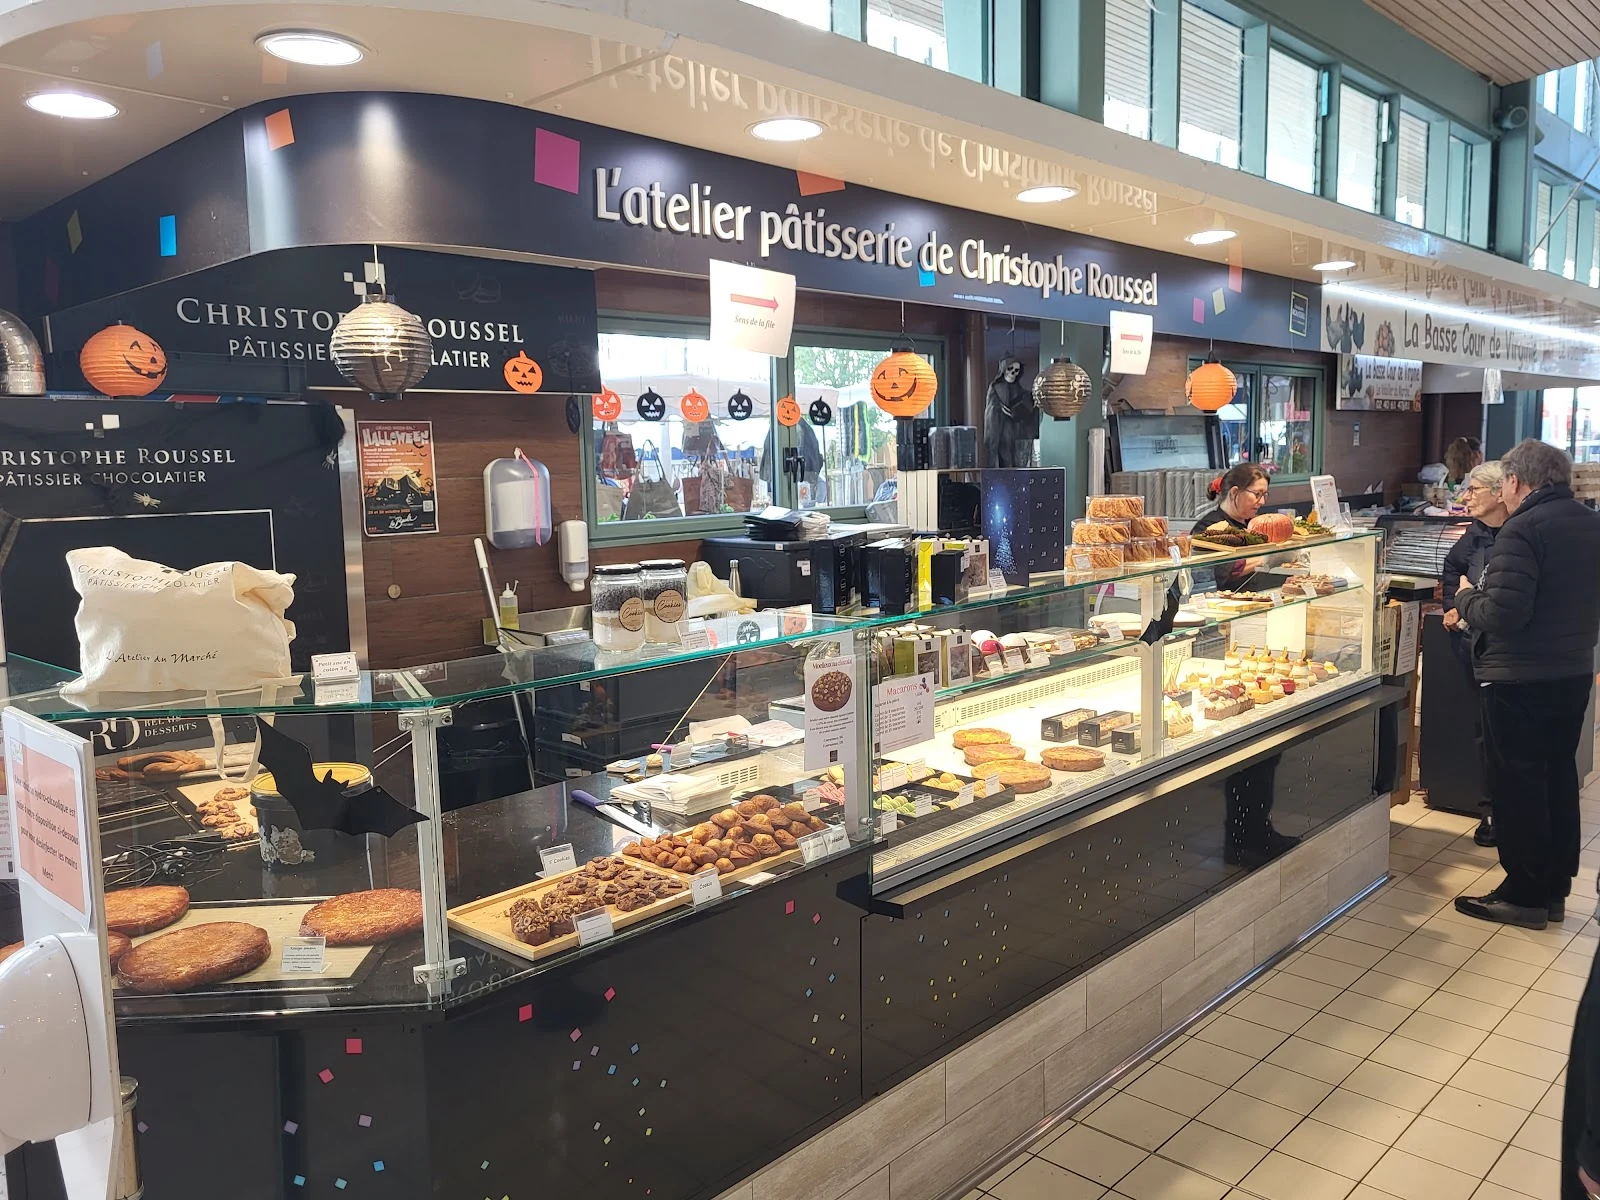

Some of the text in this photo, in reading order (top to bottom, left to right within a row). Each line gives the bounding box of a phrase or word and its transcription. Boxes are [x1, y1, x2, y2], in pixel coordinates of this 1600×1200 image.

[596, 167, 1158, 306] L'atelier pâtisserie de Christophe Roussel
[176, 298, 348, 332] CHRISTO
[735, 315, 776, 330] Sens de la file
[229, 335, 331, 361] PÂTISSIE
[1404, 310, 1419, 348] La
[1425, 314, 1457, 353] Basse
[1462, 322, 1486, 358] Cour
[1490, 327, 1500, 360] de
[1505, 330, 1537, 370] Virginie
[362, 428, 430, 447] HALLOWEEN
[138, 448, 236, 464] ROUSSEL
[90, 470, 206, 485] CHOCOLATIER
[154, 656, 167, 664] du
[170, 650, 218, 664] Marché
[887, 683, 917, 696] Macarons
[144, 722, 198, 738] DESSERTS
[35, 810, 56, 833] disposition
[57, 824, 79, 846] ci-dessous
[36, 832, 58, 858] désinfecter
[64, 854, 78, 870] mains
[42, 866, 54, 882] Merci
[700, 881, 713, 890] Cookie
